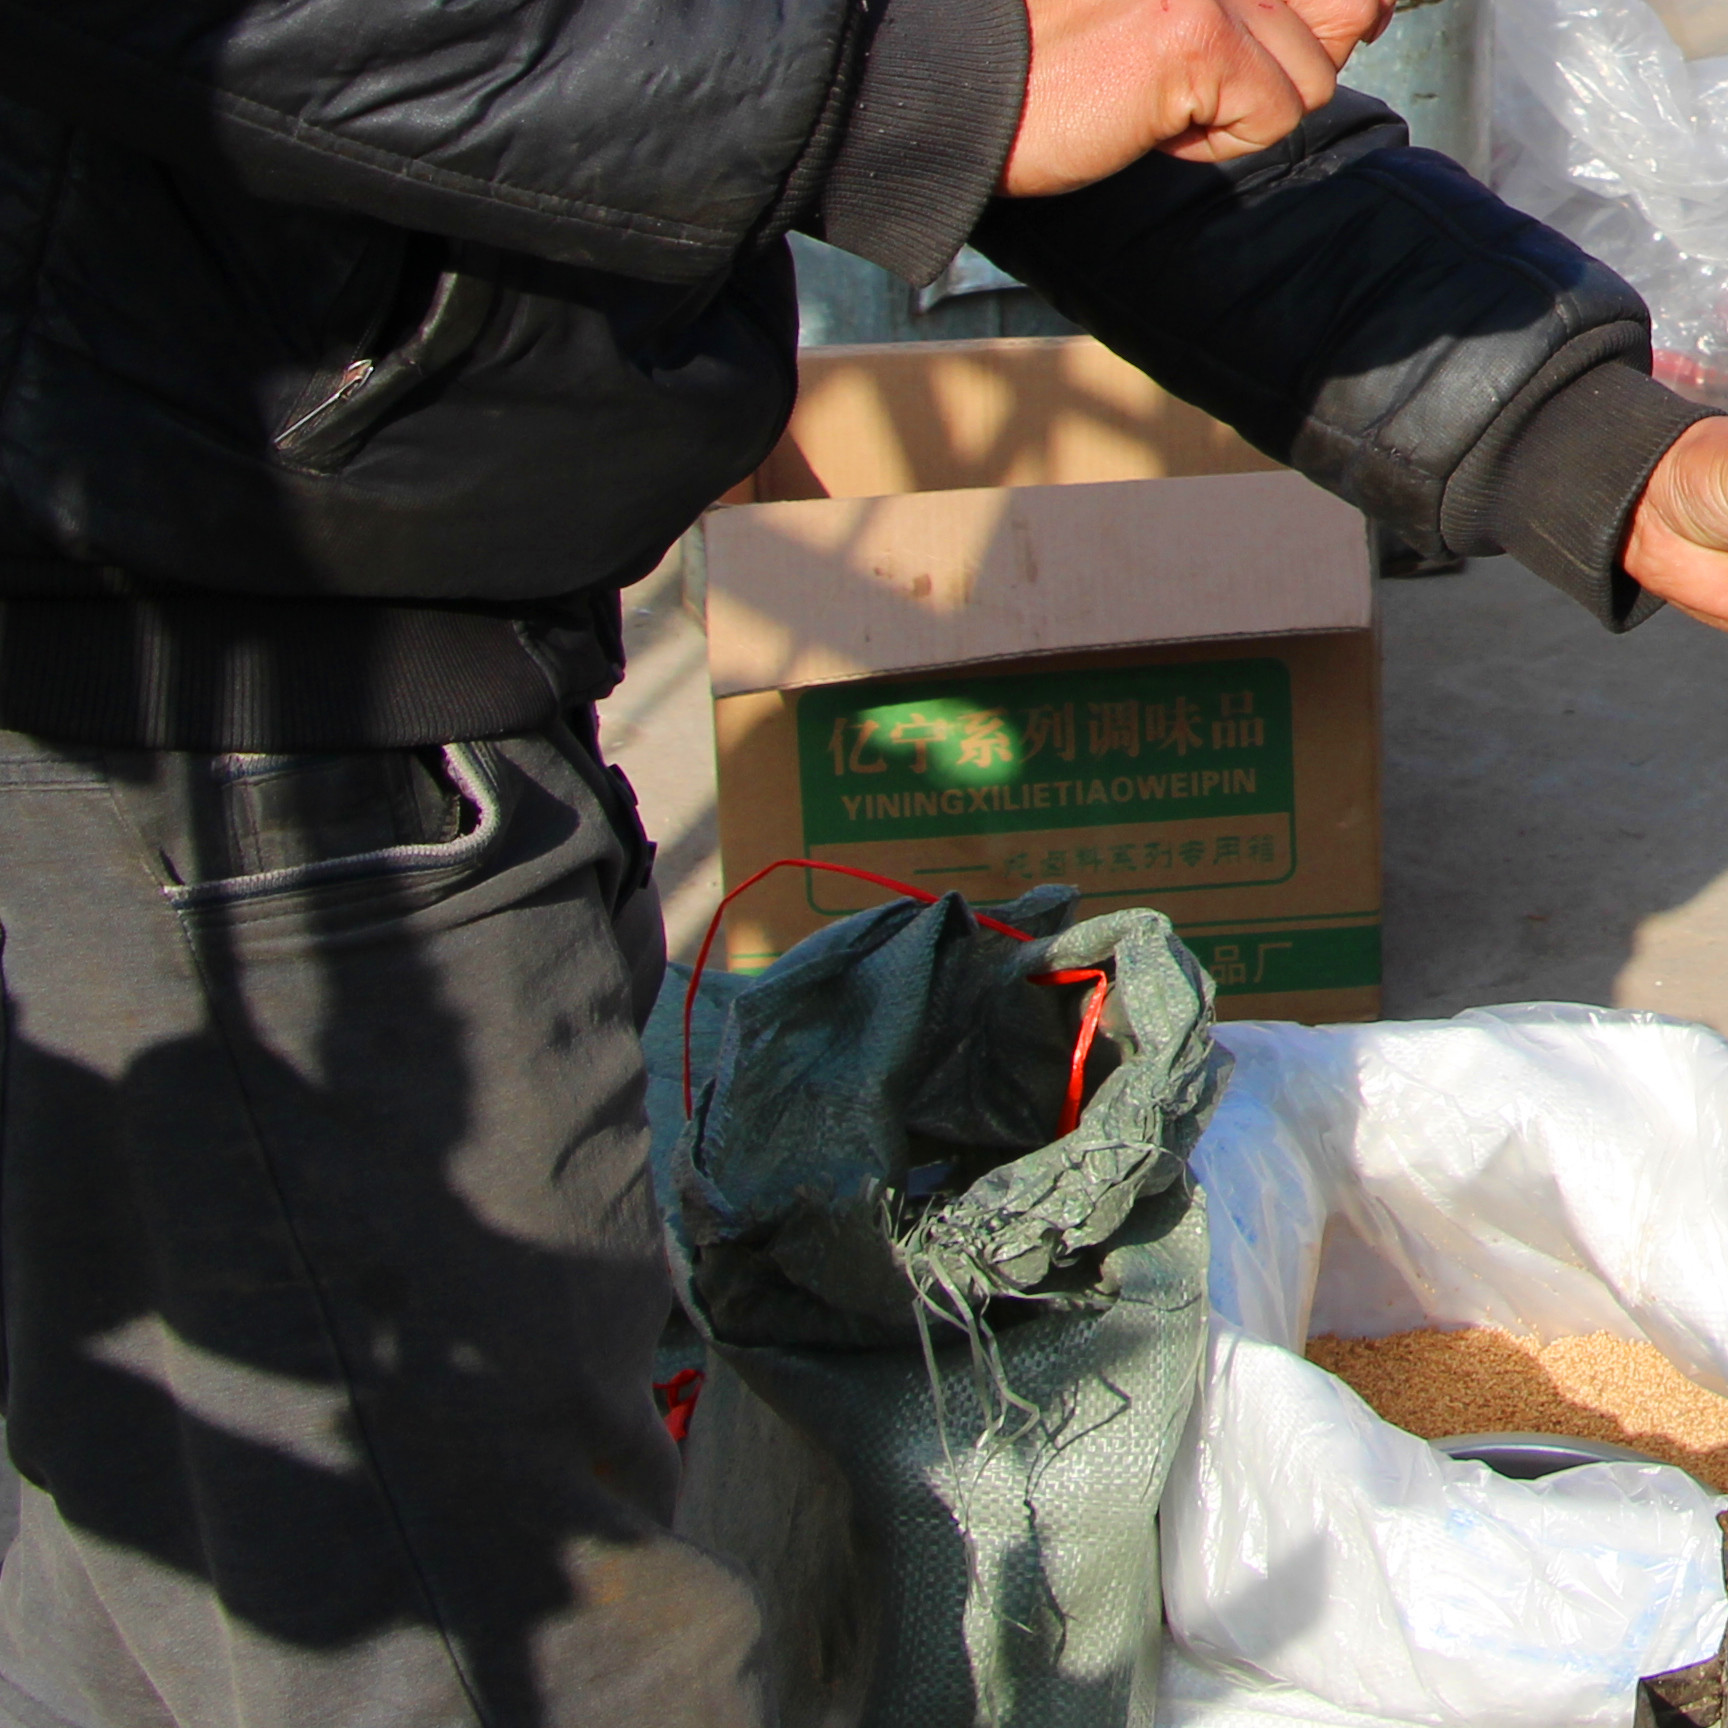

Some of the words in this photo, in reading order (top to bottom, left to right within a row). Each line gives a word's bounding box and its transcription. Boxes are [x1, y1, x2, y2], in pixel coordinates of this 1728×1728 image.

[827, 689, 1266, 777] 亿宁系列调味品
[840, 768, 1258, 822] YININGXILIETIAOWEIPIN
[1208, 941, 1294, 985] 品厂
